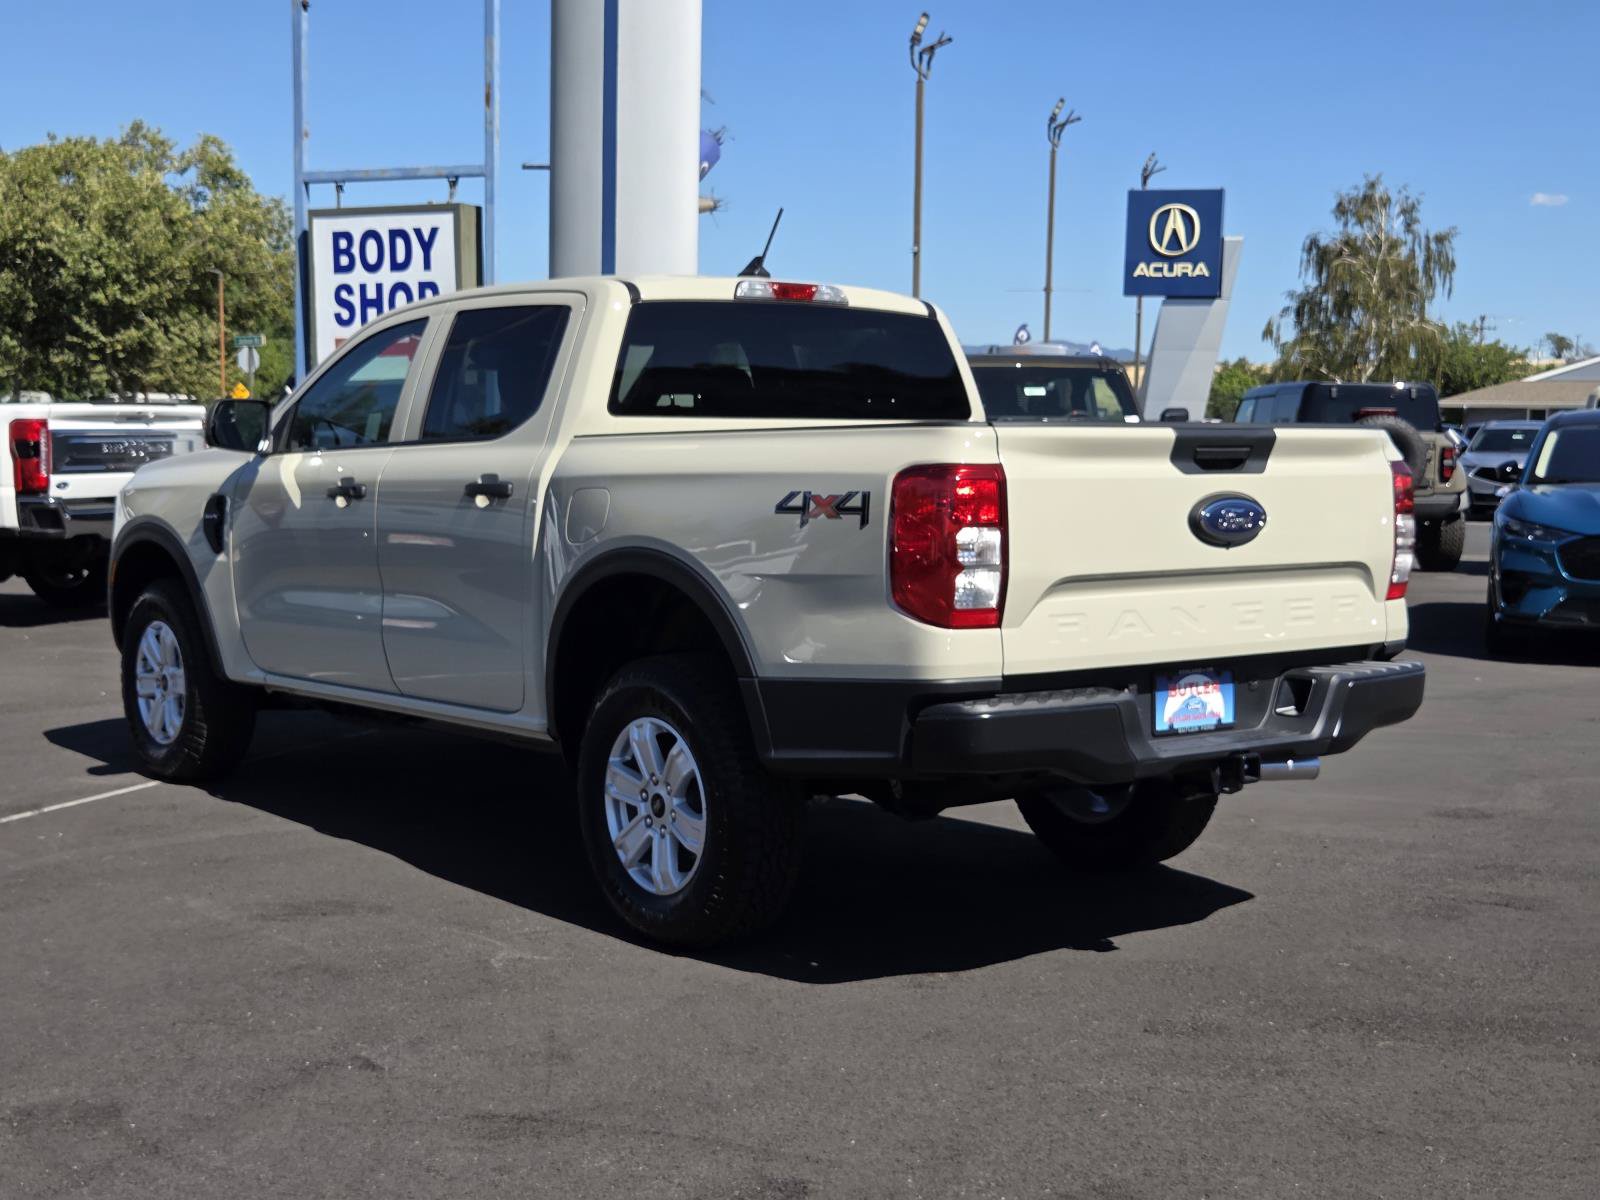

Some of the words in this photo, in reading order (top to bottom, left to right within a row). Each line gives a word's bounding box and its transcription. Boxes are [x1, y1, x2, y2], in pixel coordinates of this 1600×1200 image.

[332, 227, 440, 274] BODY
[1132, 261, 1210, 278] ACURA
[1168, 680, 1220, 698] BUTLER
